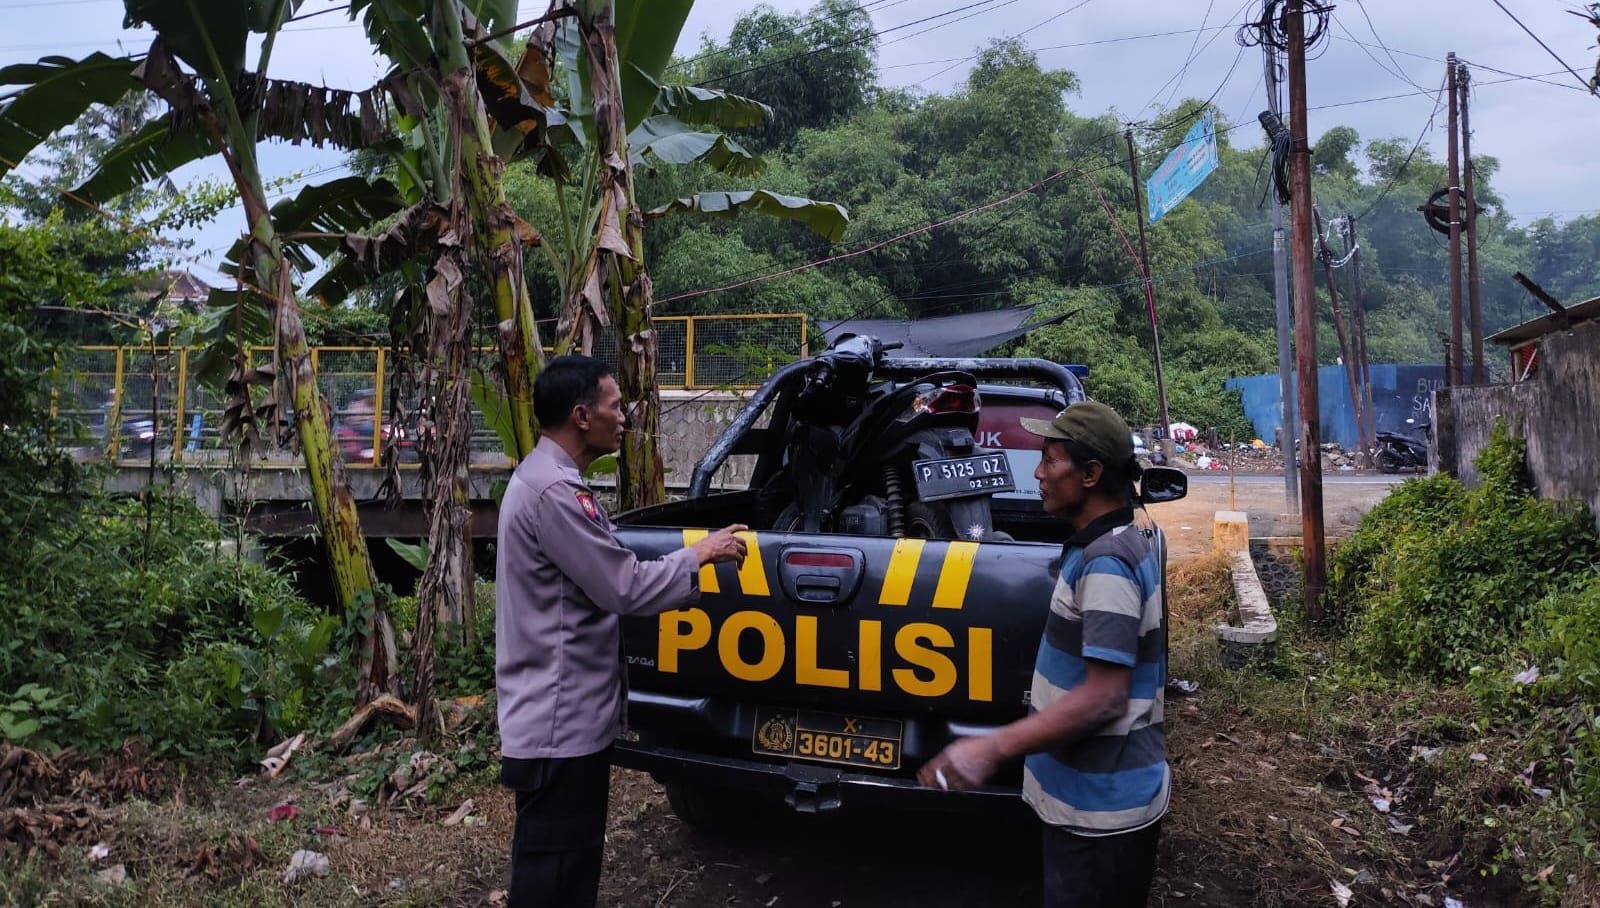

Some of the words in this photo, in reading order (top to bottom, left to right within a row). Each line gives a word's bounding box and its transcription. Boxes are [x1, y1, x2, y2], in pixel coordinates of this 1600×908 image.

[923, 467, 932, 482] P
[942, 462, 975, 479] 5125
[657, 607, 993, 702] POLISI
[843, 718, 857, 733] X
[799, 733, 894, 764] 3601-43
